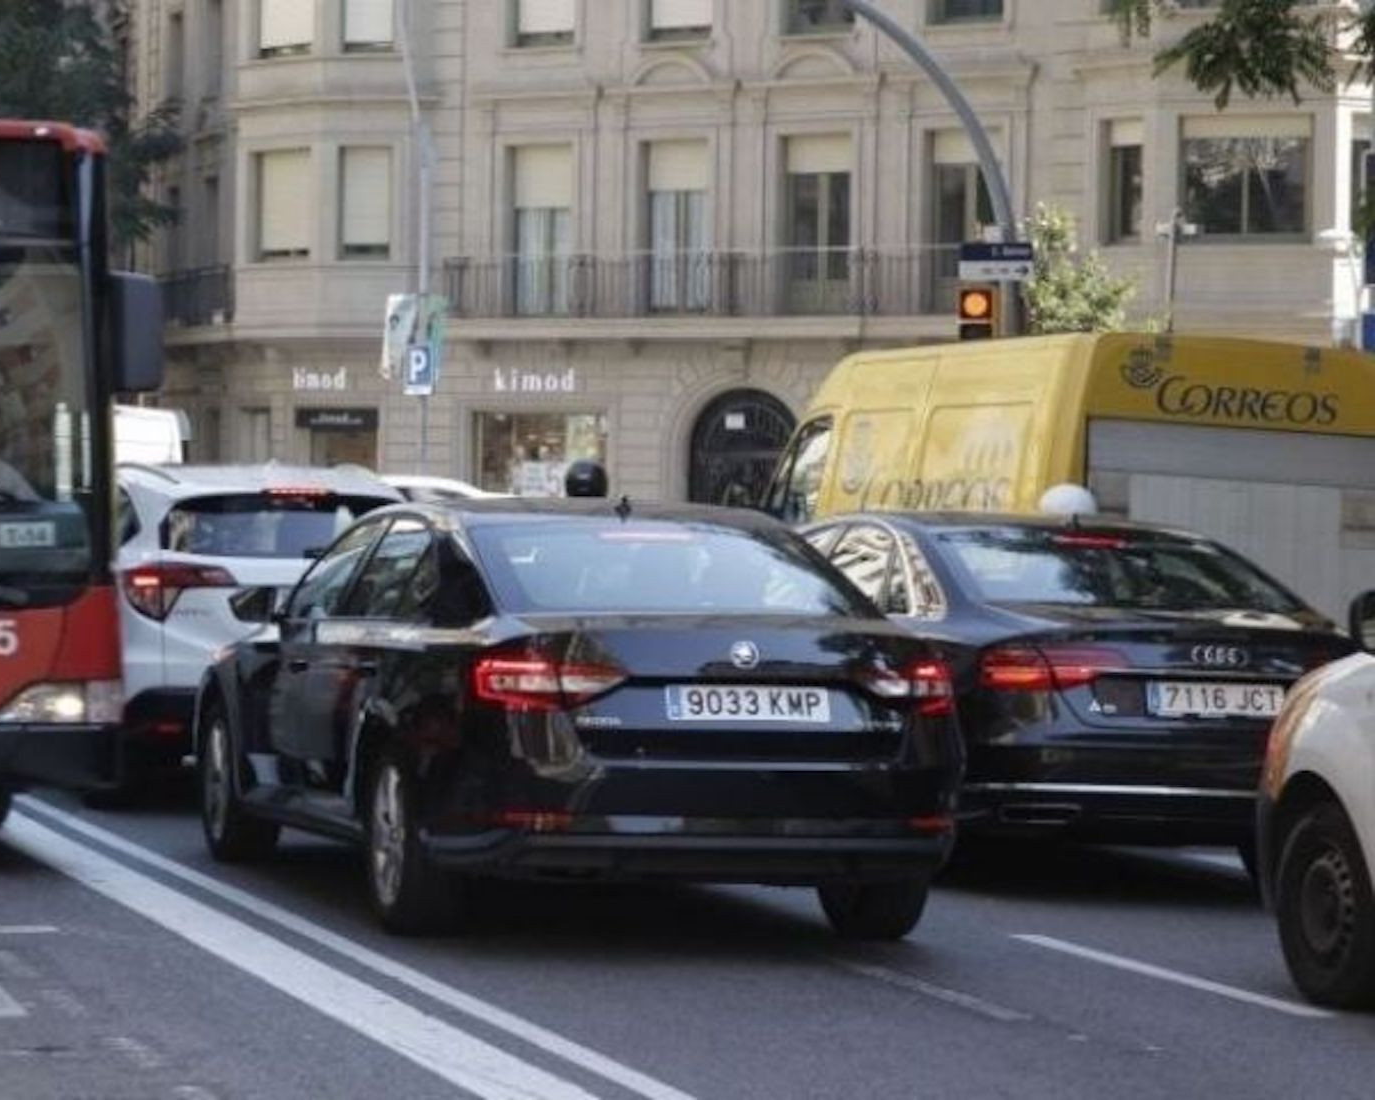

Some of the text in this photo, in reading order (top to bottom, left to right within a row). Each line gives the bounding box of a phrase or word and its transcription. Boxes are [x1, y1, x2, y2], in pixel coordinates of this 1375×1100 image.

[409, 350, 427, 382] P
[494, 367, 574, 391] kimod
[1156, 375, 1339, 425] CORREOS
[687, 690, 821, 716] 9033 KMP
[1166, 687, 1228, 709] 7116
